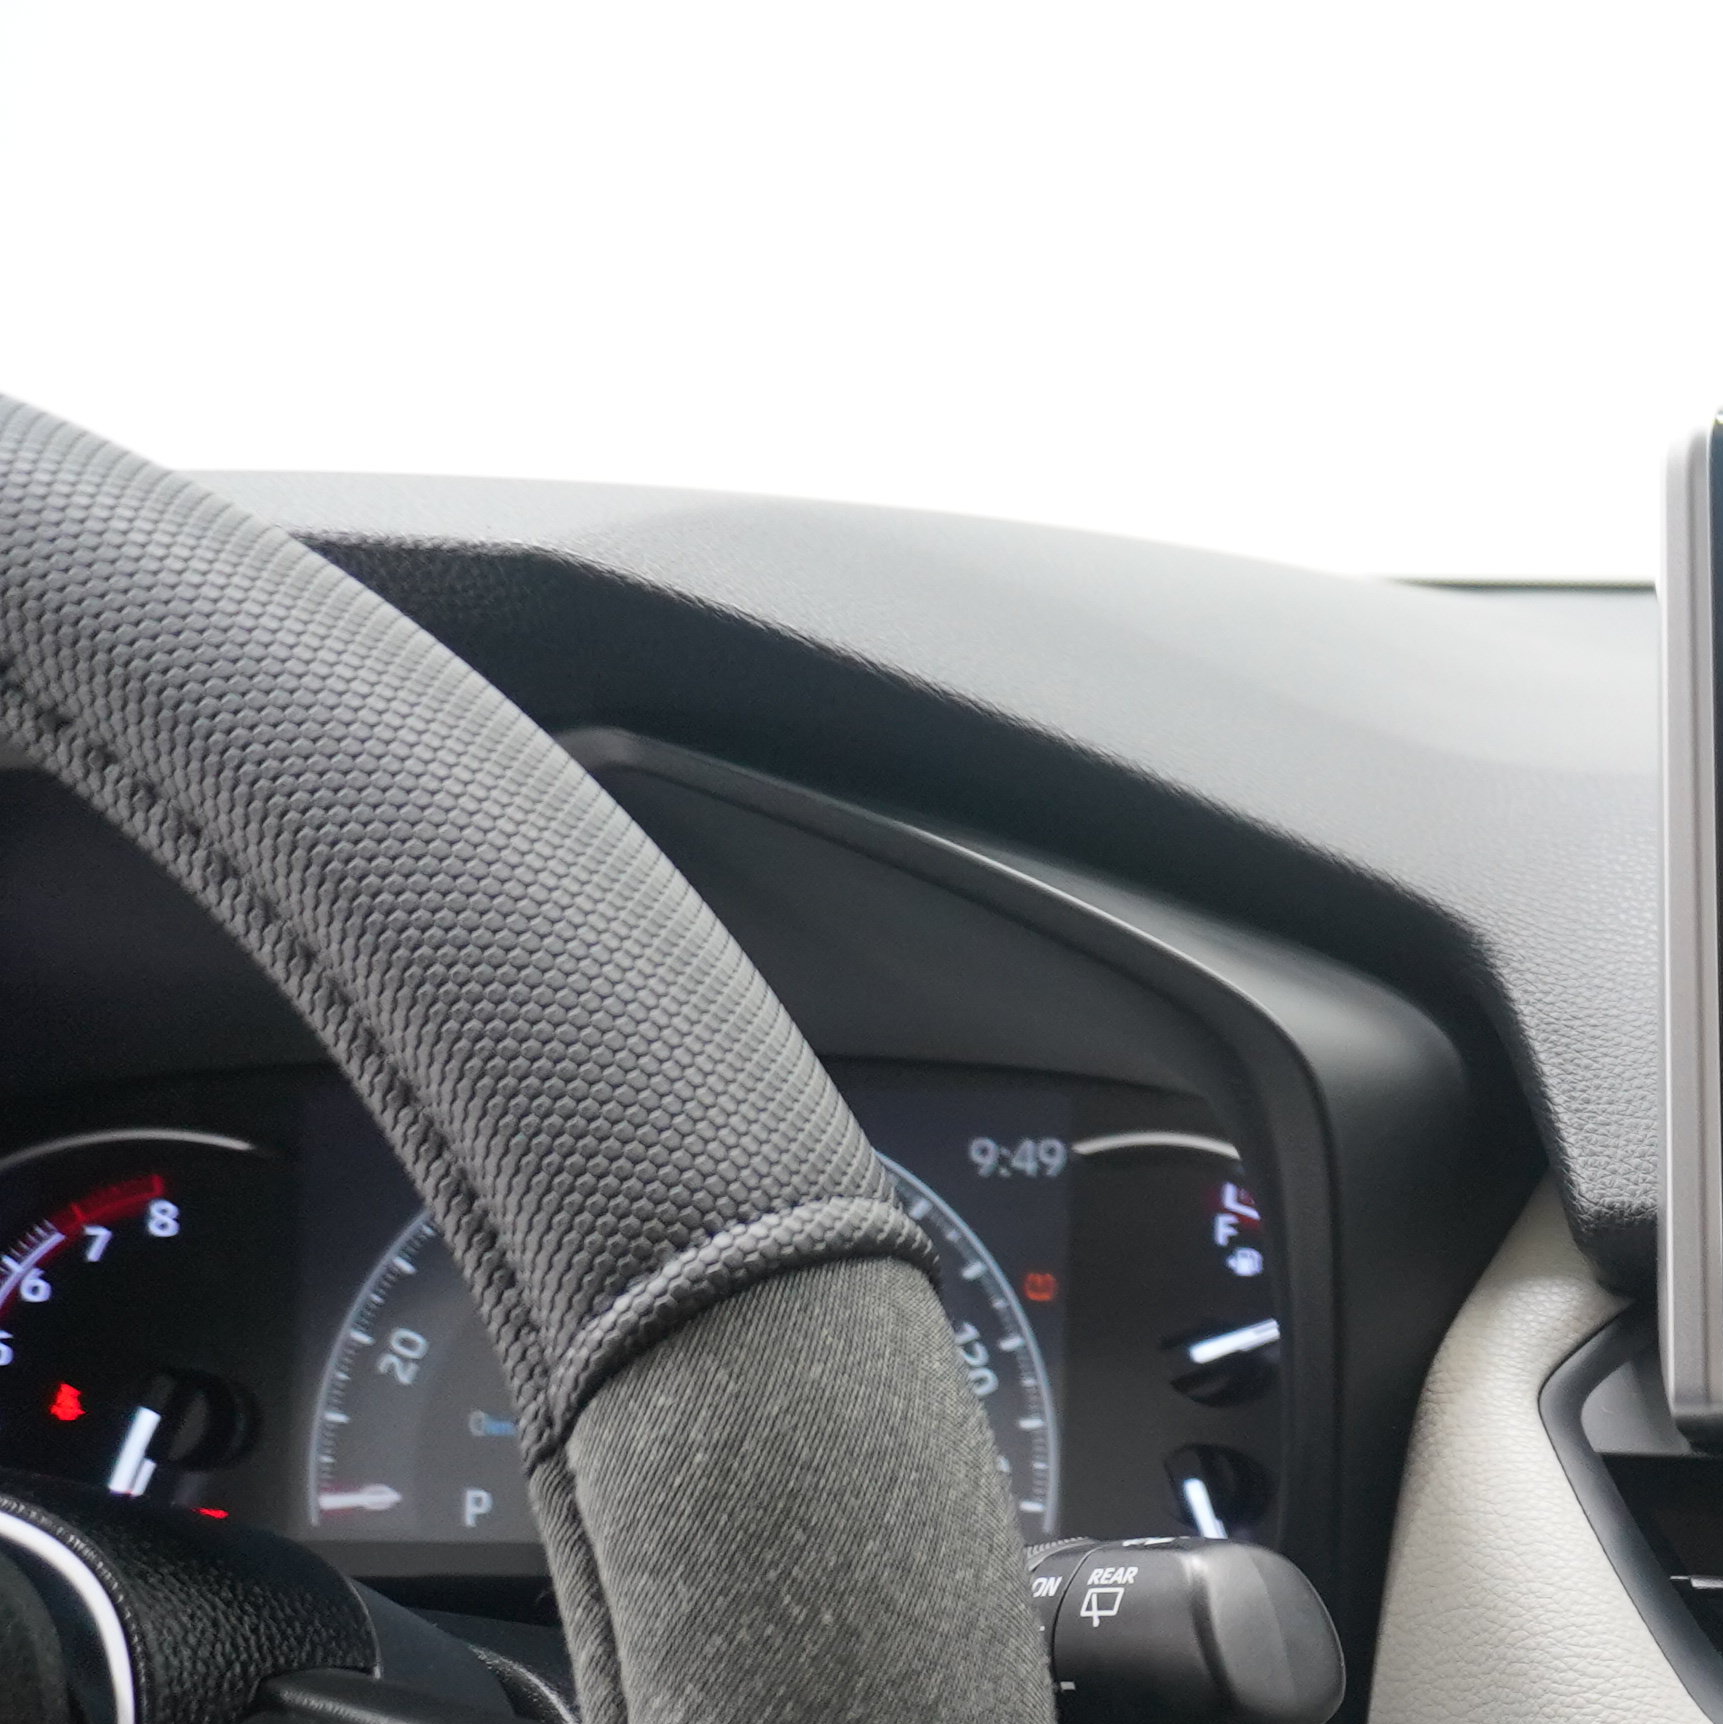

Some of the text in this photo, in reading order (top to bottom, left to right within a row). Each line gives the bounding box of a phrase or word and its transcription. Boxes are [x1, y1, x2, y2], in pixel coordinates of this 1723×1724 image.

[968, 1136, 1069, 1179] 9:49
[147, 1200, 181, 1237] 8
[1213, 1212, 1240, 1247] F
[84, 1225, 113, 1262] 7
[20, 1267, 52, 1302] 6
[378, 1328, 429, 1386] 20
[465, 1488, 493, 1528] P
[1086, 1566, 1139, 1586] REAR
